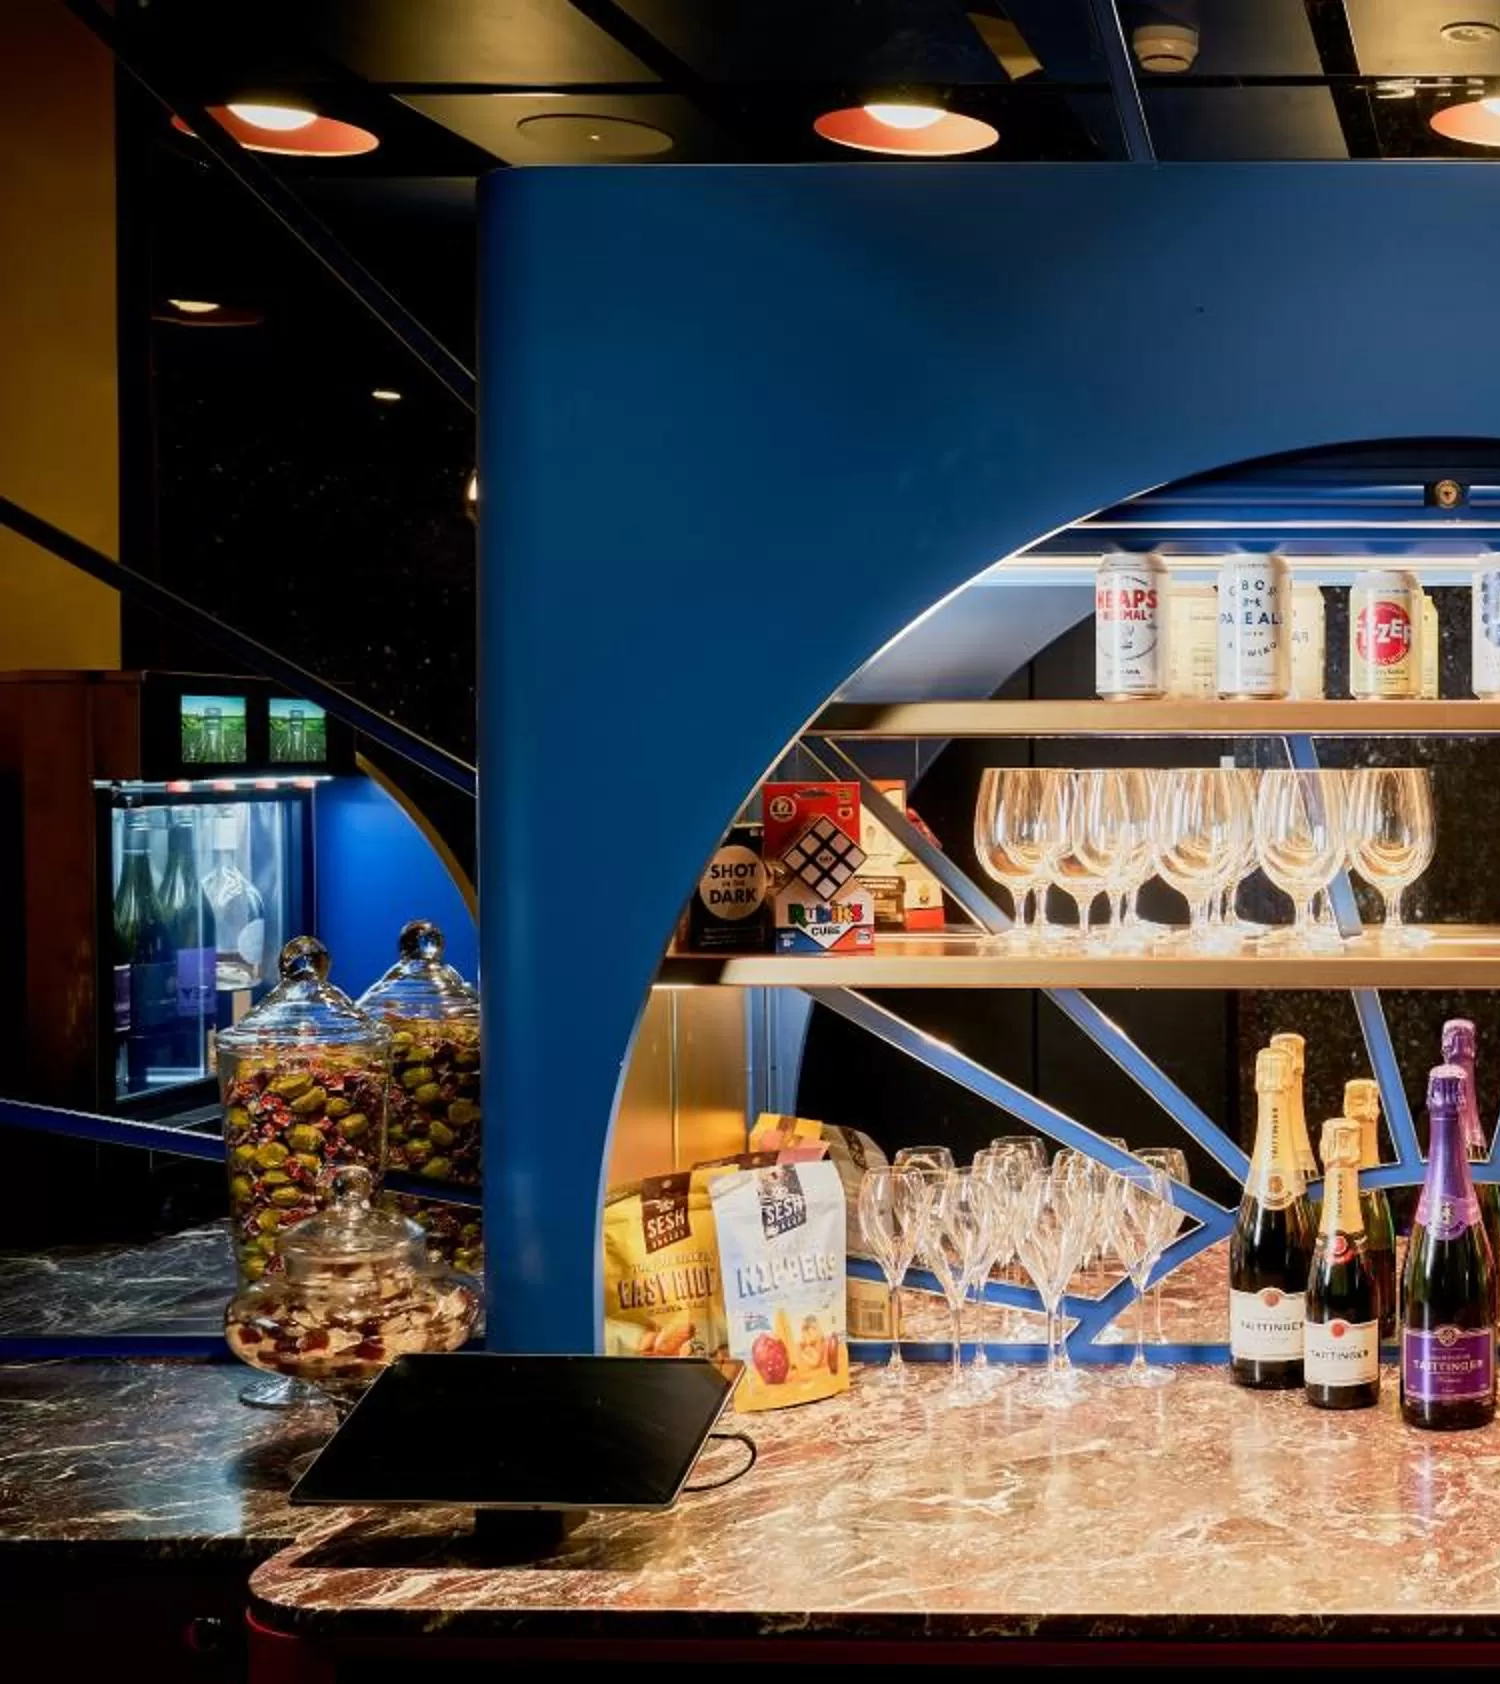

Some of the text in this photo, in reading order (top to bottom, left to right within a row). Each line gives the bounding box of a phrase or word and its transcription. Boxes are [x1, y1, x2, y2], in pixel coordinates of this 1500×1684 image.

[1219, 611, 1253, 625] PAE
[711, 863, 757, 879] SHOT
[710, 887, 758, 905] DARK
[766, 1197, 805, 1225] SESH
[647, 1207, 686, 1239] SESH
[617, 1271, 669, 1310] EASY
